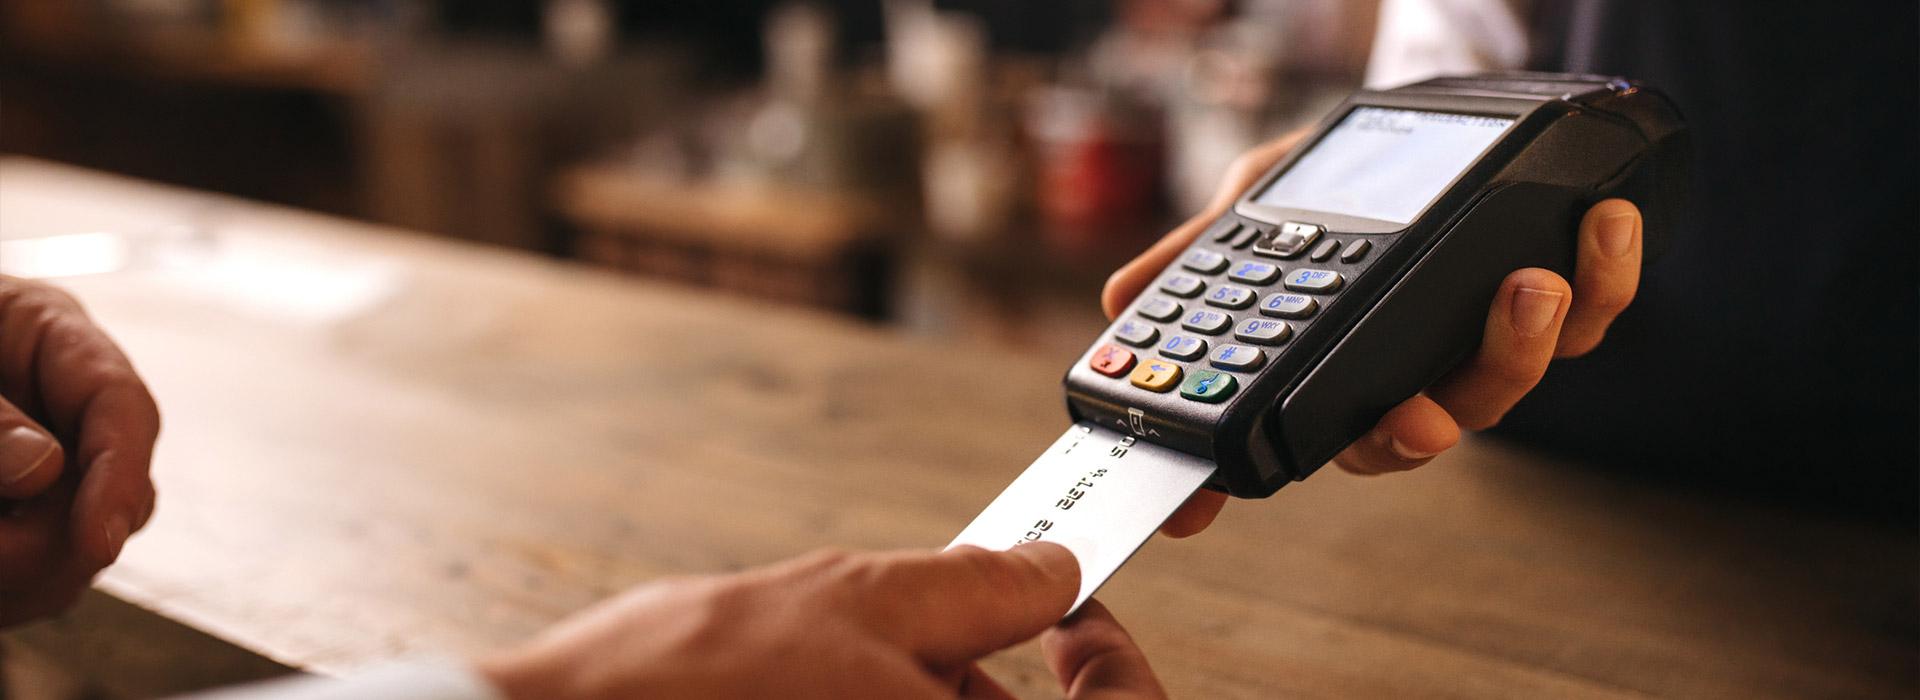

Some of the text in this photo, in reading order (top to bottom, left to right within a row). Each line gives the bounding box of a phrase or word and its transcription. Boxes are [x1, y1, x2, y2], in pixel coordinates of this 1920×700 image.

[1295, 271, 1311, 284] 3
[1213, 287, 1229, 299] 5
[1269, 295, 1284, 308] 6
[1190, 312, 1204, 324] 8
[1244, 321, 1281, 334] 9 WXY
[1166, 336, 1182, 349] 0
[1016, 519, 1054, 544] 20
